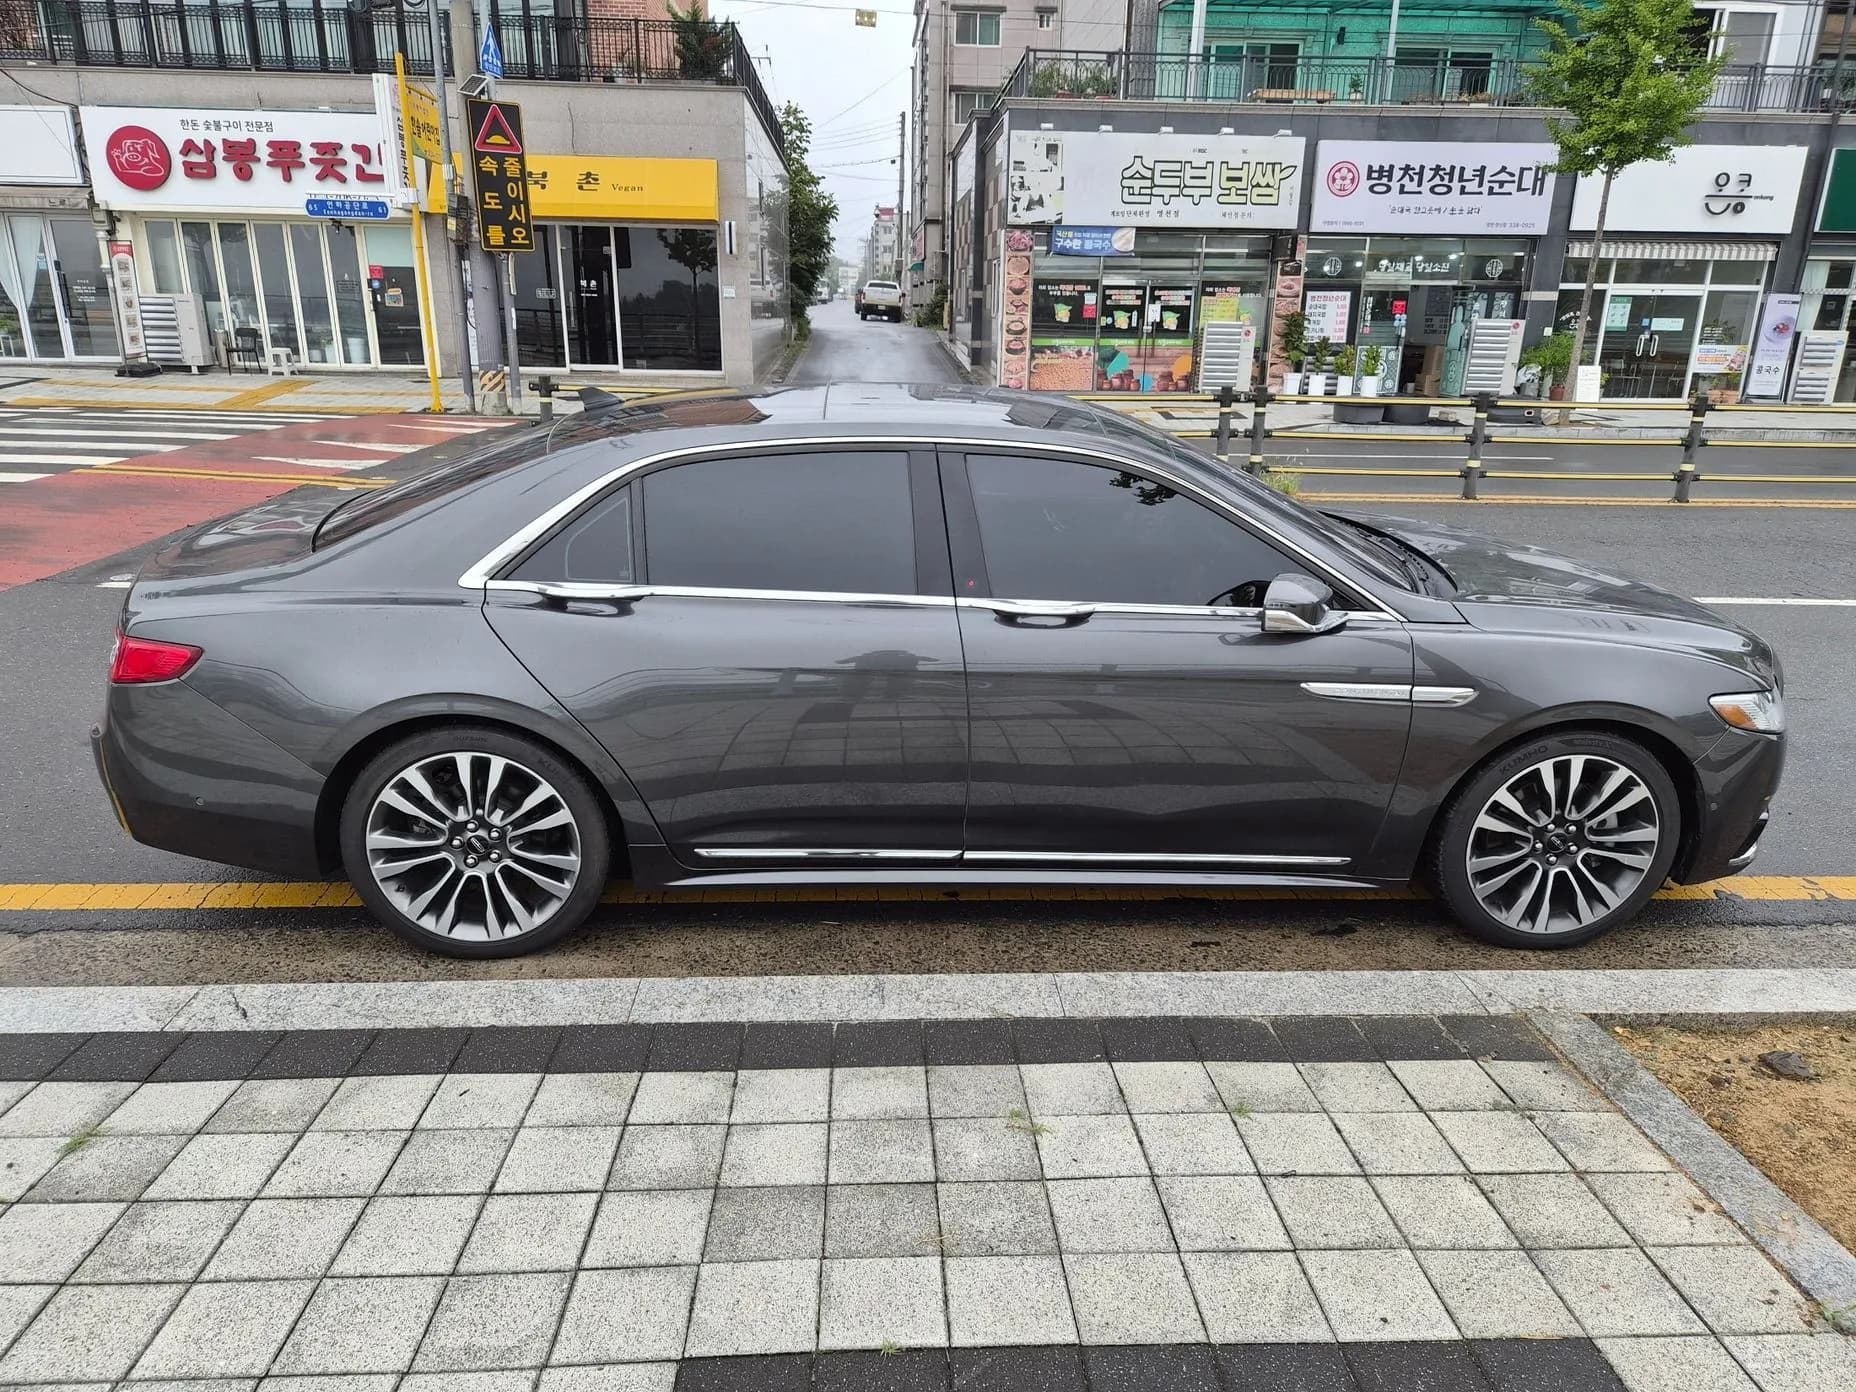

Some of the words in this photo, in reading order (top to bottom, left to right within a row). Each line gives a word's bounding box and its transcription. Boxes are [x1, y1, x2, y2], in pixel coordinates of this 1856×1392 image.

[180, 119, 200, 131] 한돈
[203, 119, 242, 132] 숯불구이
[245, 120, 274, 133] 전문점
[612, 183, 644, 192] Vegan
[1366, 163, 1548, 196] 병천청년순대
[503, 157, 530, 244] 줄이시오
